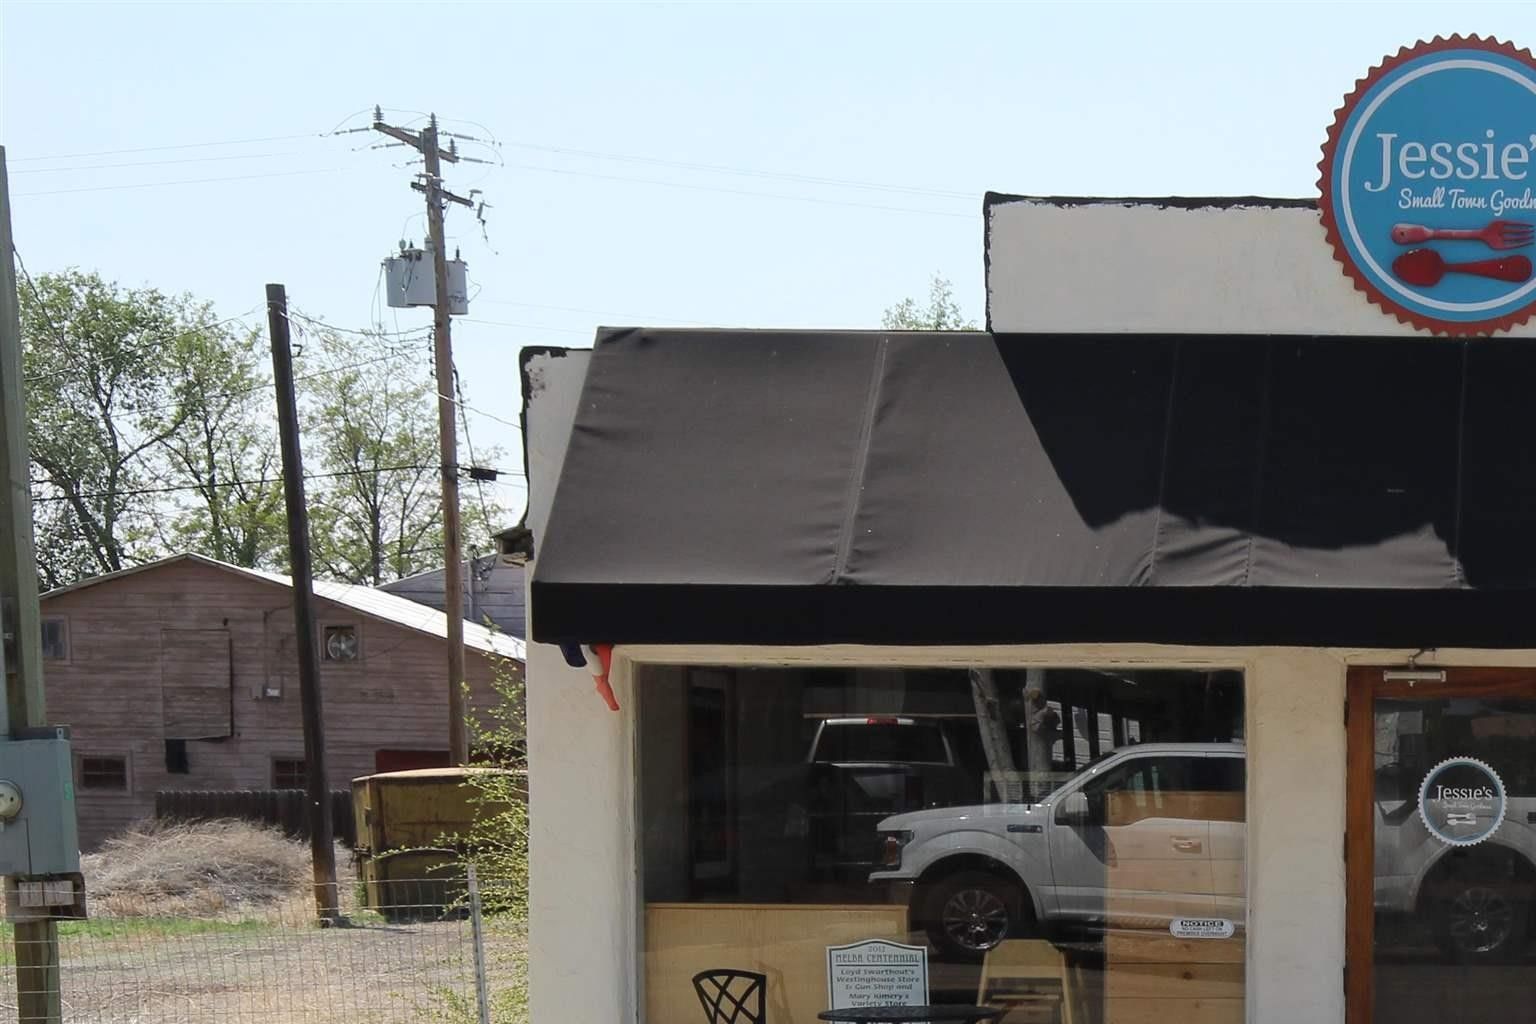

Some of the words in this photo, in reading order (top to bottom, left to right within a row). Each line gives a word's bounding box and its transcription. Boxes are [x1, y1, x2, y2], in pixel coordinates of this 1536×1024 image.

[1398, 187, 1446, 209] Small
[1449, 190, 1486, 209] Town
[1432, 785, 1493, 802] Jessie's
[835, 954, 863, 963] MELBA
[866, 954, 920, 963] CENTENNIAL
[836, 976, 897, 984] Westinghouse
[855, 983, 870, 991] Gun
[873, 983, 894, 992] Shop
[896, 982, 913, 991] and
